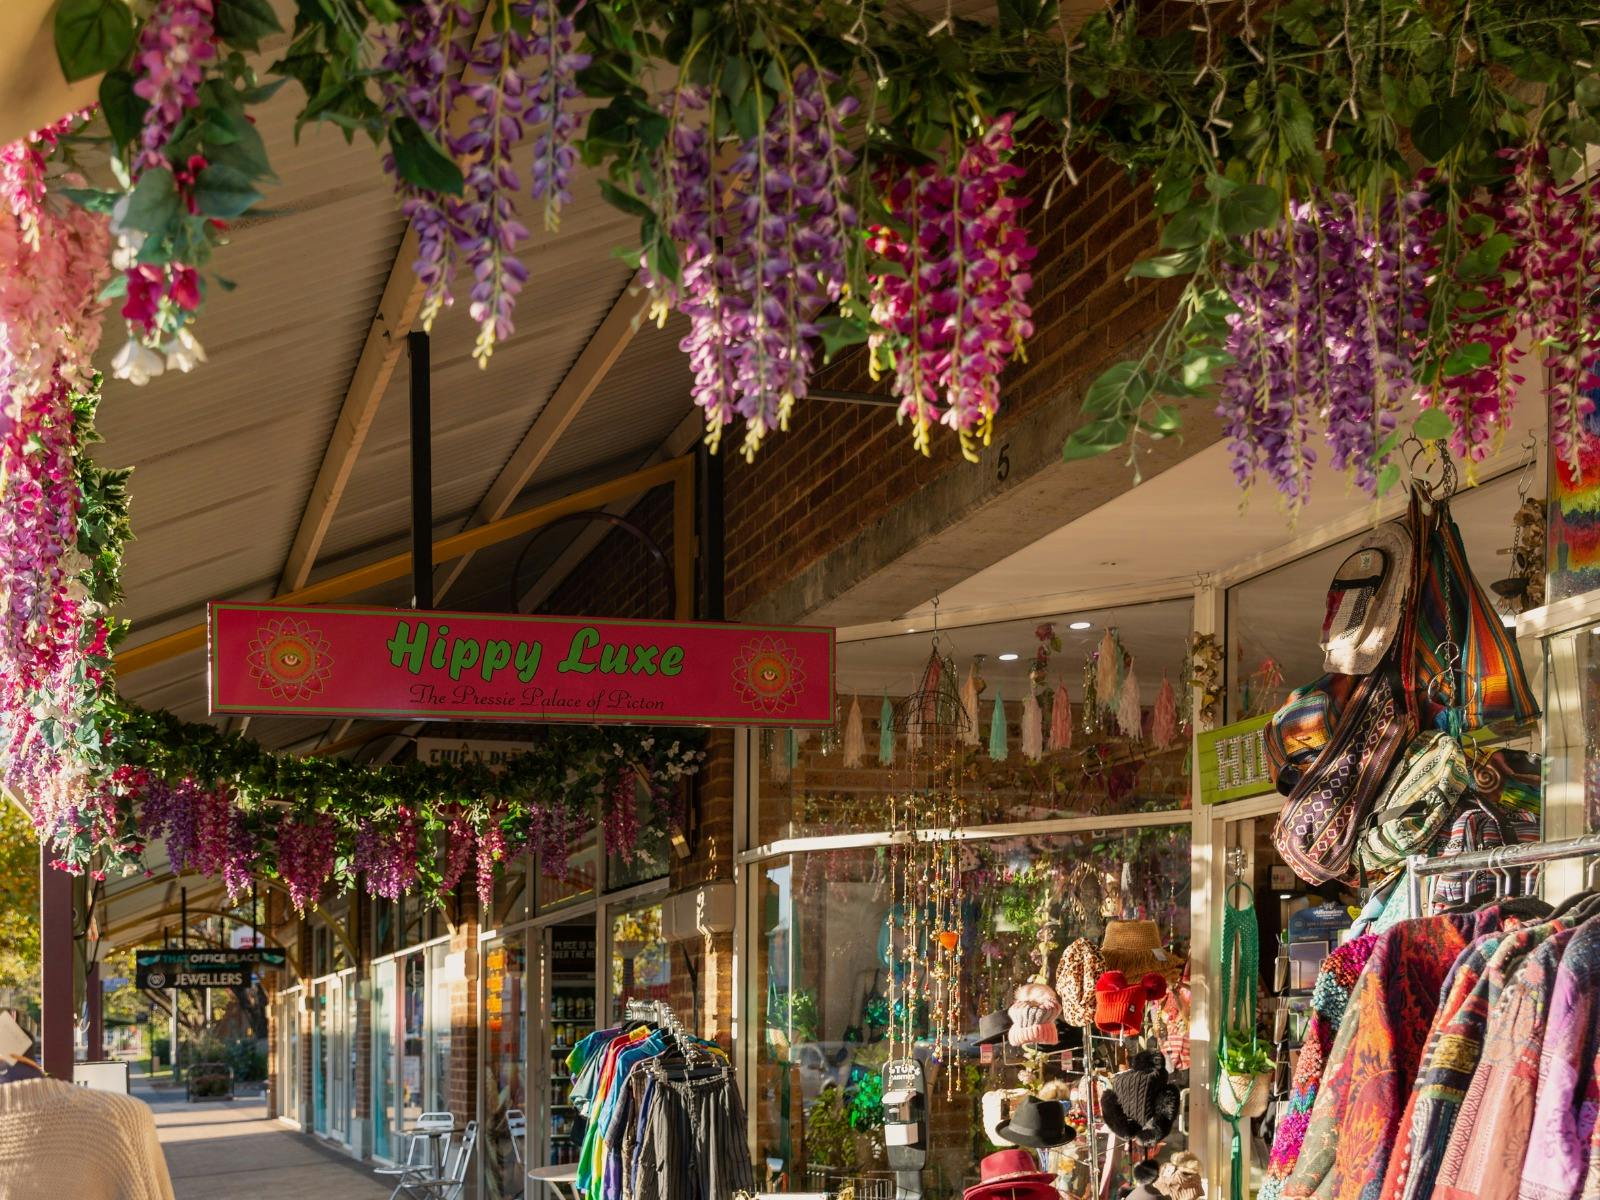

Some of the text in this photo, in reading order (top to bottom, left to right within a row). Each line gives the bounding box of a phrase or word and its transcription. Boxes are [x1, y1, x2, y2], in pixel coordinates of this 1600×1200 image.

[997, 443, 1010, 481] 5
[386, 620, 685, 684] Hippy Luxe
[409, 683, 665, 711] The Pressie Palace of Picton
[163, 953, 260, 964] THAT OFFICE PLACE
[174, 972, 243, 986] JEWELLERS
